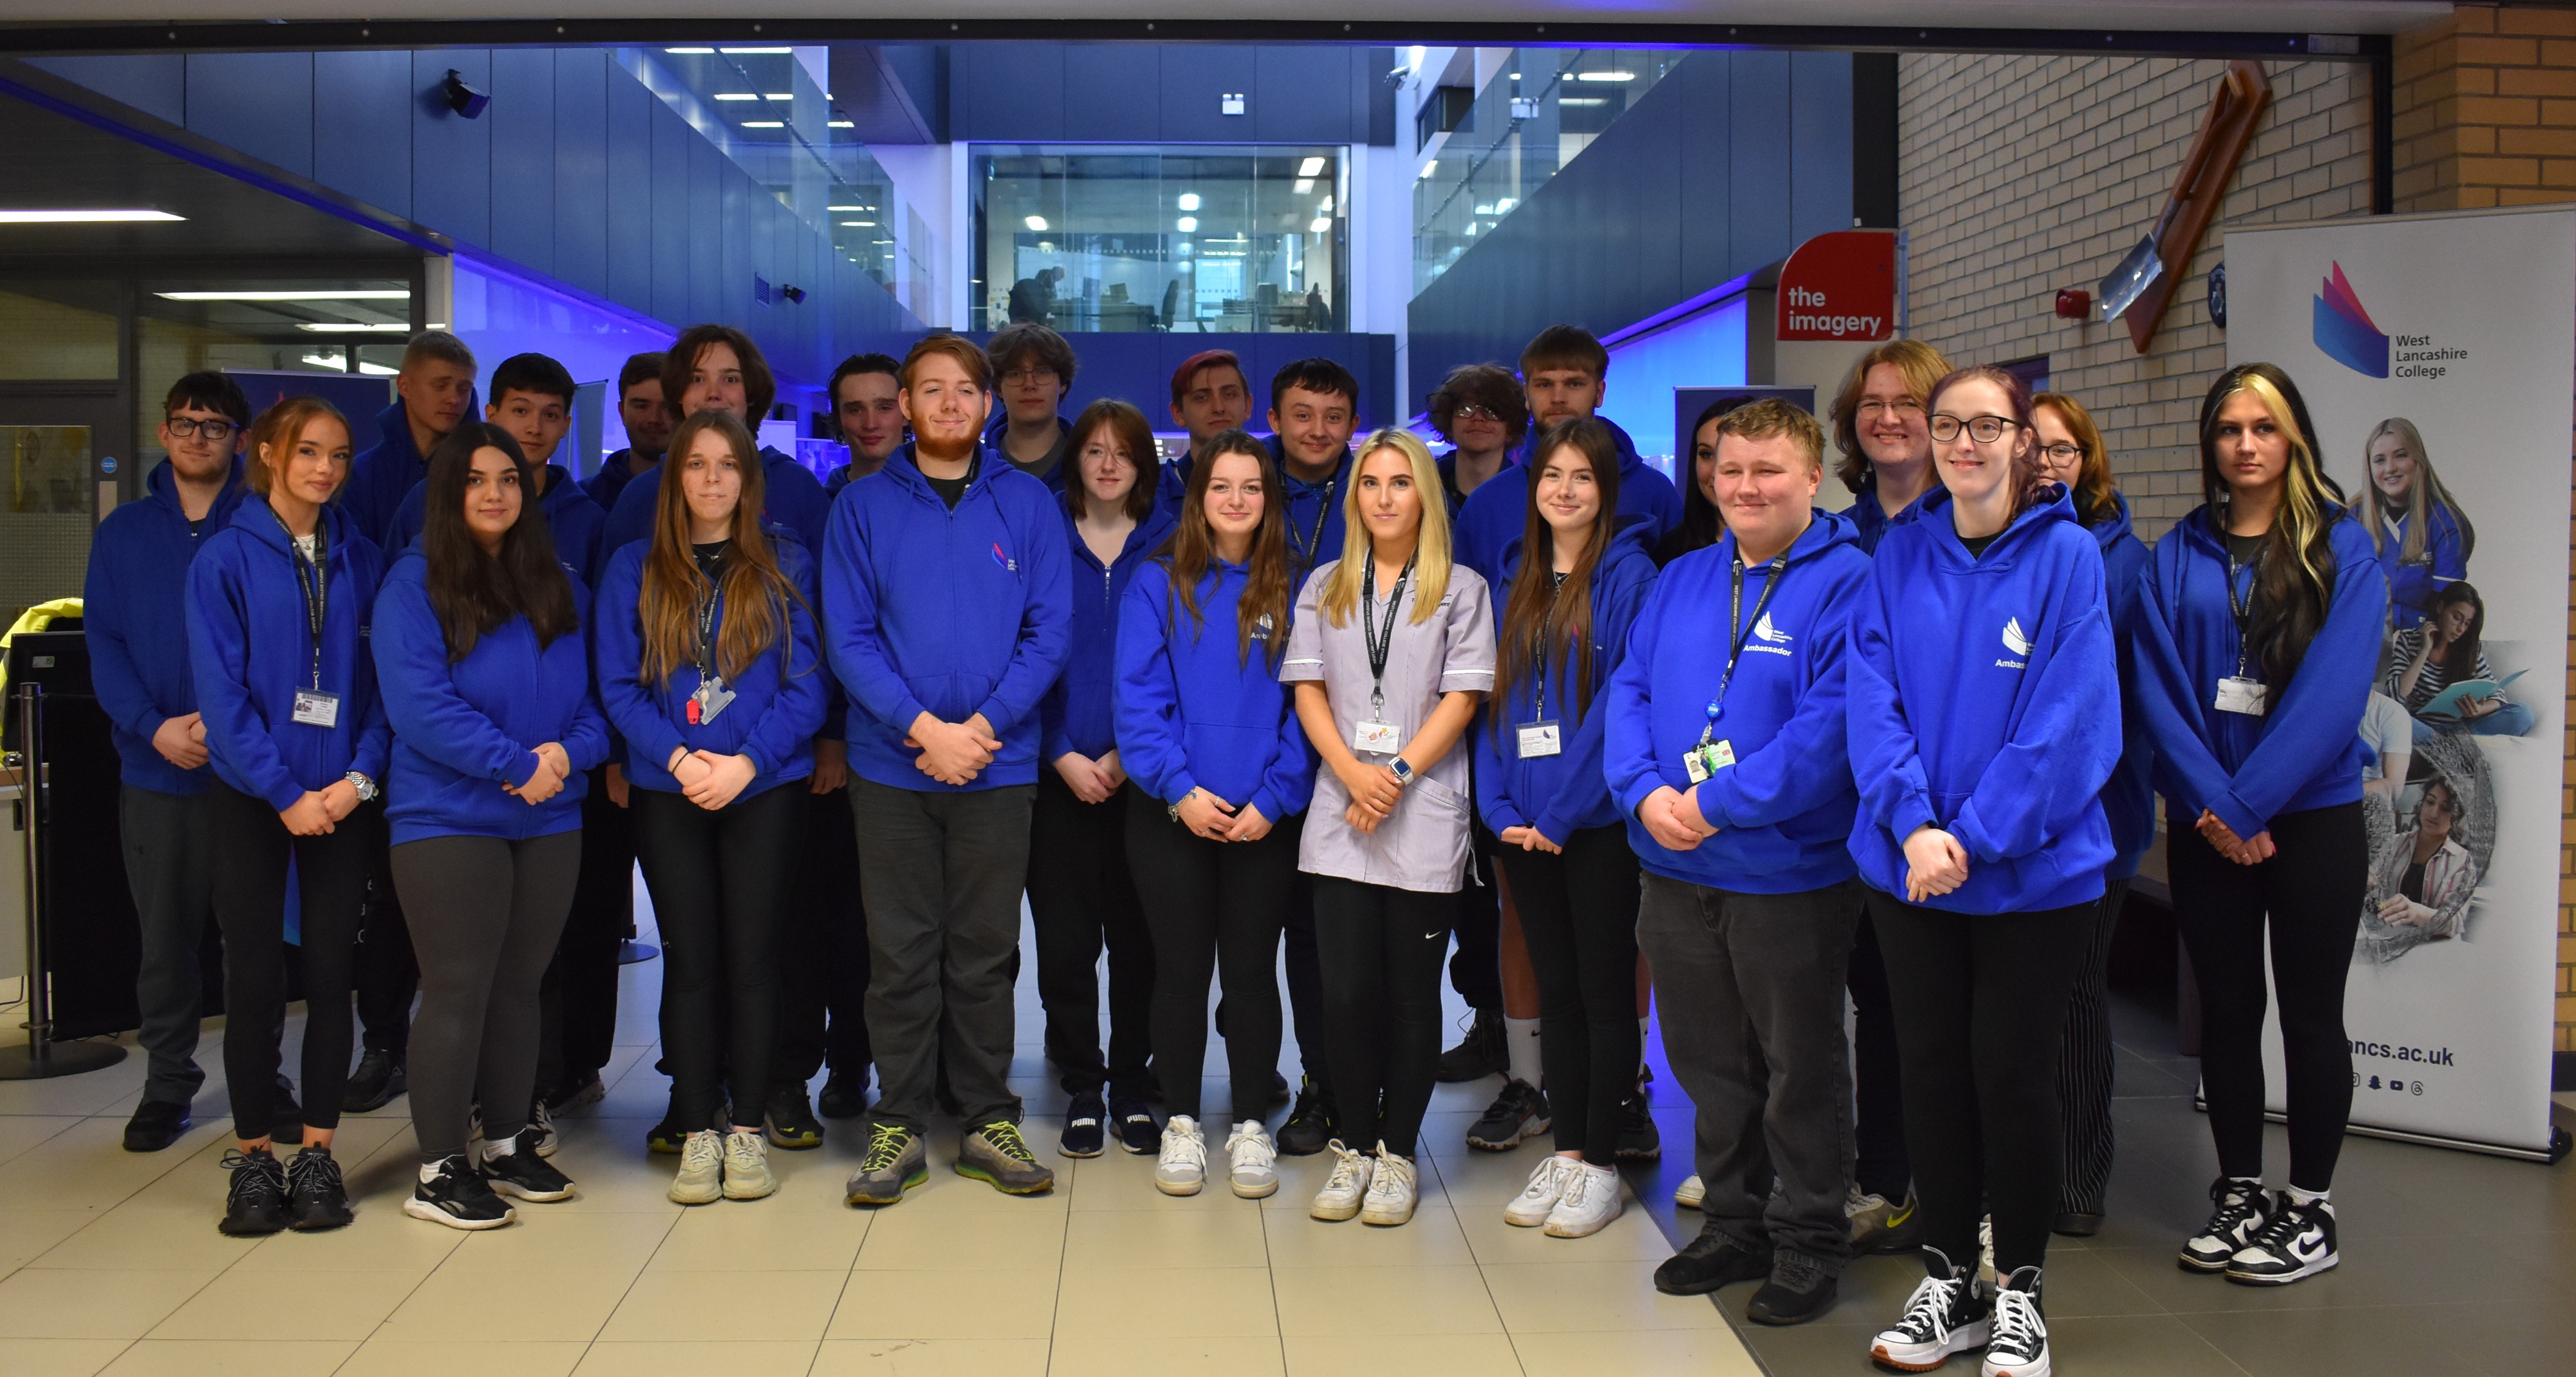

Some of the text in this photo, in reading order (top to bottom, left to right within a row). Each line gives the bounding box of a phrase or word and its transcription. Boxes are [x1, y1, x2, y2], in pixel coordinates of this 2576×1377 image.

[1788, 286, 1825, 307] the
[1789, 310, 1881, 336] imagery
[2396, 335, 2430, 346] West
[2396, 347, 2467, 362] Lancashire
[2395, 365, 2446, 379] College
[1743, 645, 1792, 656] Ambassador
[1071, 1118, 1096, 1128] PUMA
[1127, 1114, 1151, 1123] PUMA
